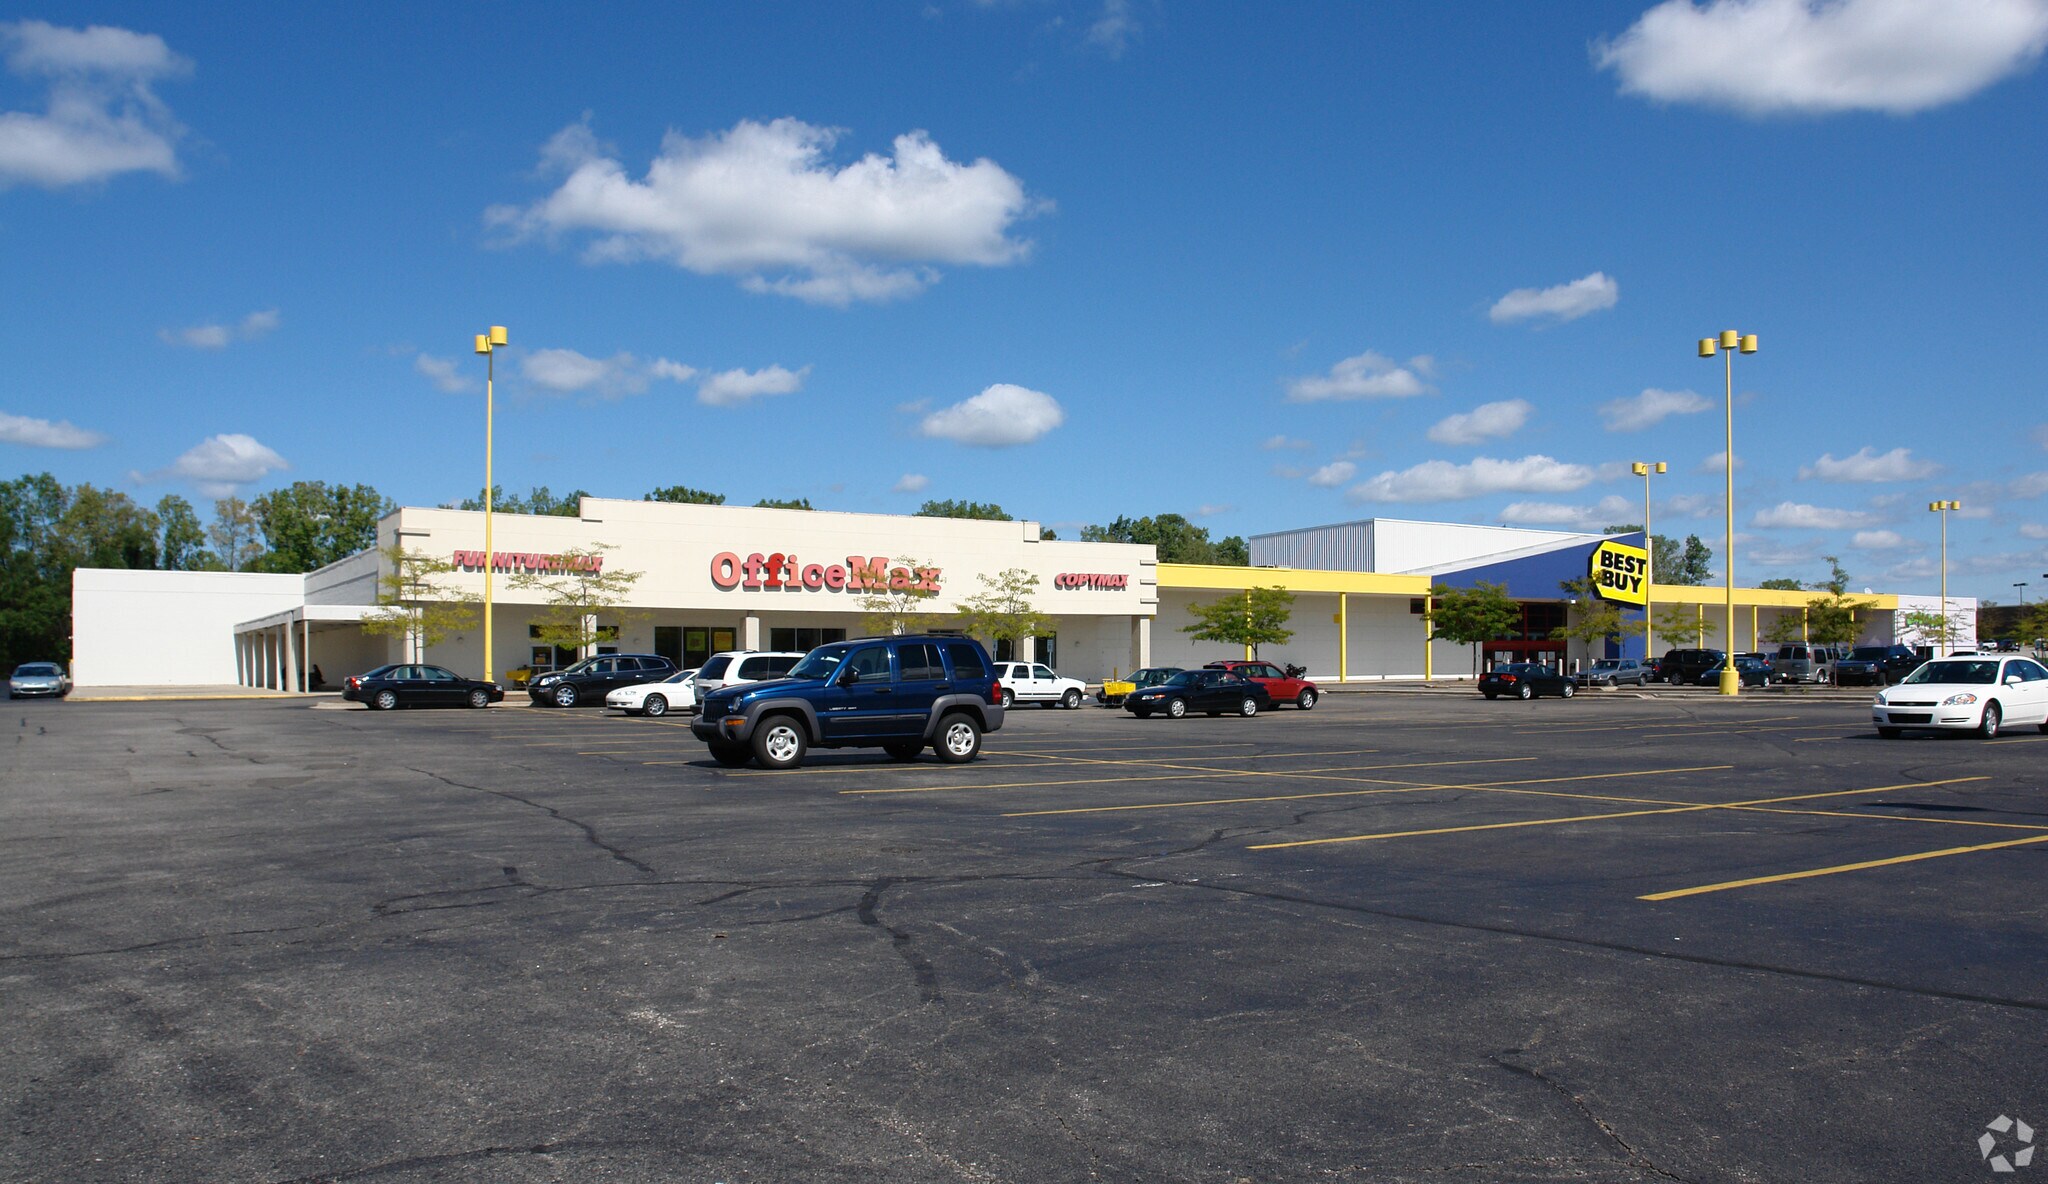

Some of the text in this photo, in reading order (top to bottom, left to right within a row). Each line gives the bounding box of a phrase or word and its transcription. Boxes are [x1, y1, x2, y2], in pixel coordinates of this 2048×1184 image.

[711, 551, 942, 591] OfficeMax
[1600, 550, 1646, 575] BEST
[1055, 573, 1129, 588] COPYMAX
[1602, 570, 1642, 593] BUY
